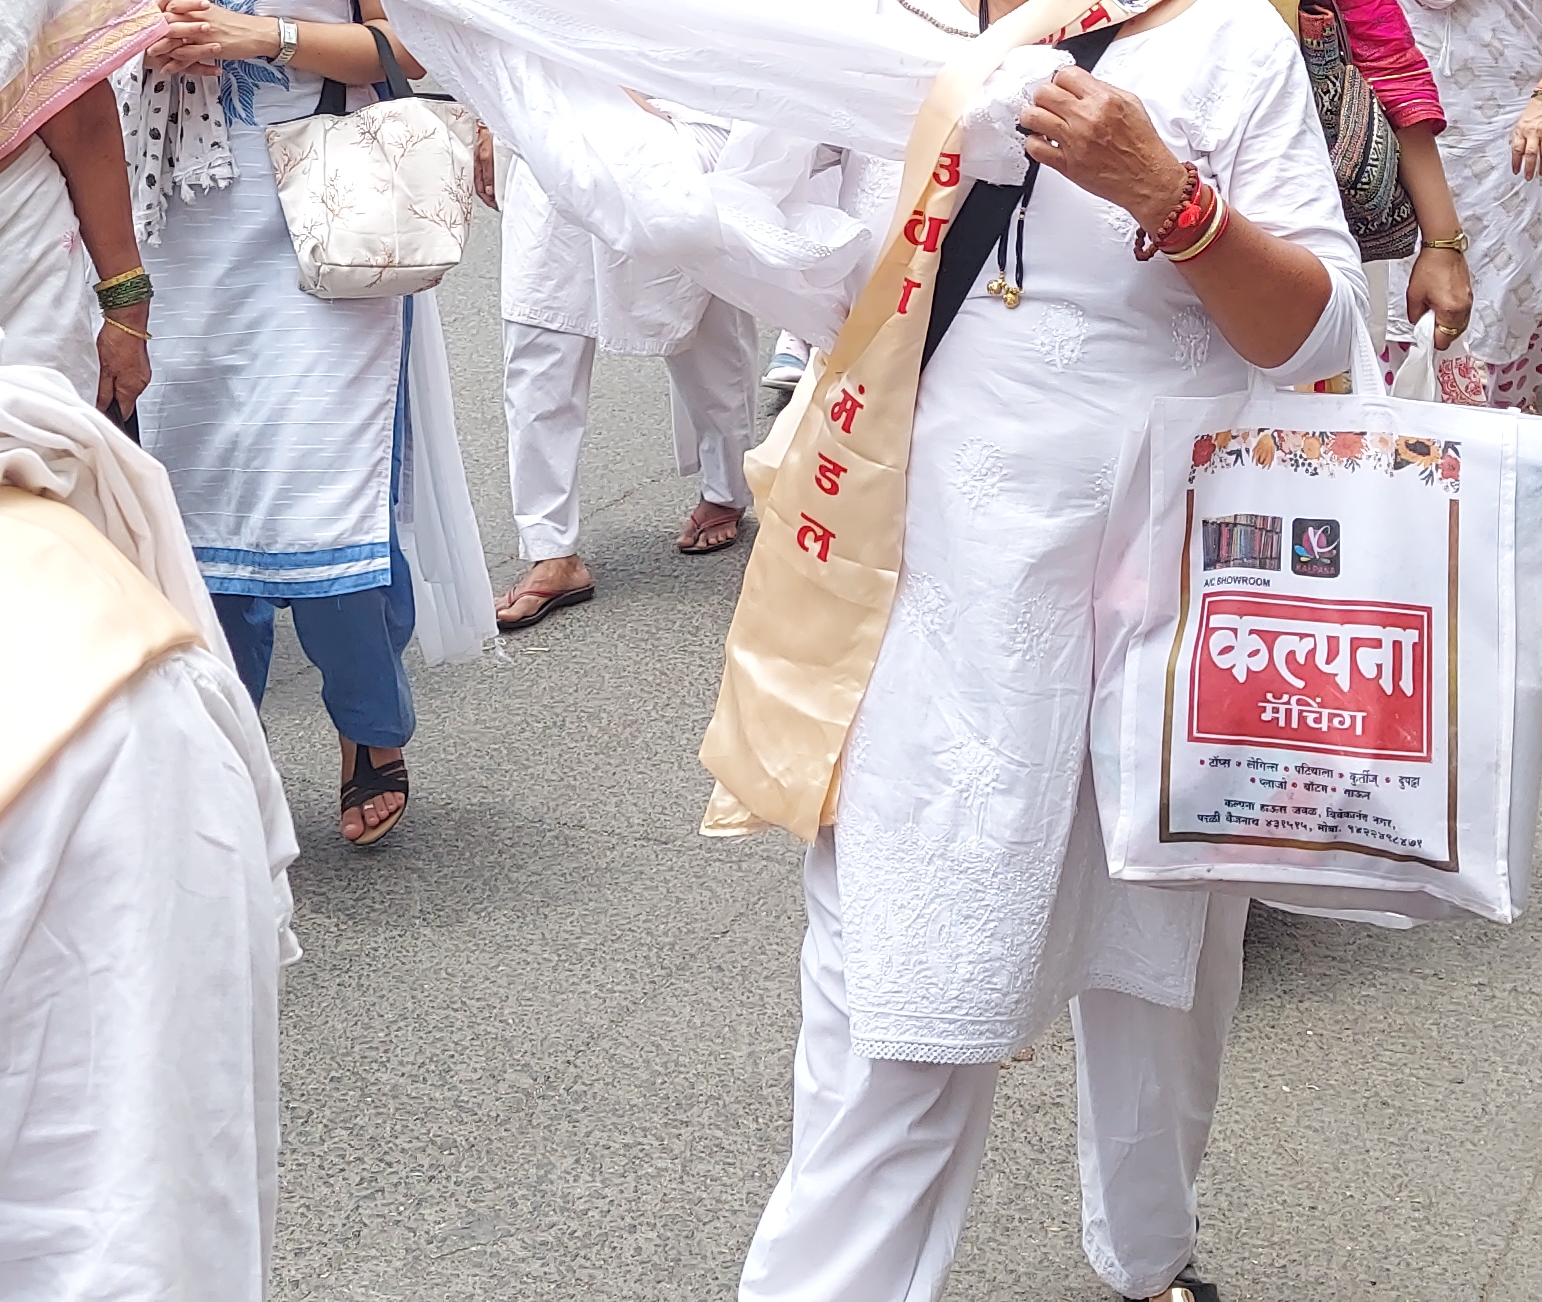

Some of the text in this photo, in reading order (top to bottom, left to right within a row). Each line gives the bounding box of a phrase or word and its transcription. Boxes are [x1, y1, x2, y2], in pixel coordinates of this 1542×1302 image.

[1295, 564, 1337, 575] KALPANA
[1216, 575, 1271, 588] SHOWROOM
[1209, 614, 1420, 698] कल्पना
[1258, 692, 1368, 737] मॅचिंग
[1295, 764, 1335, 779] पटियाला
